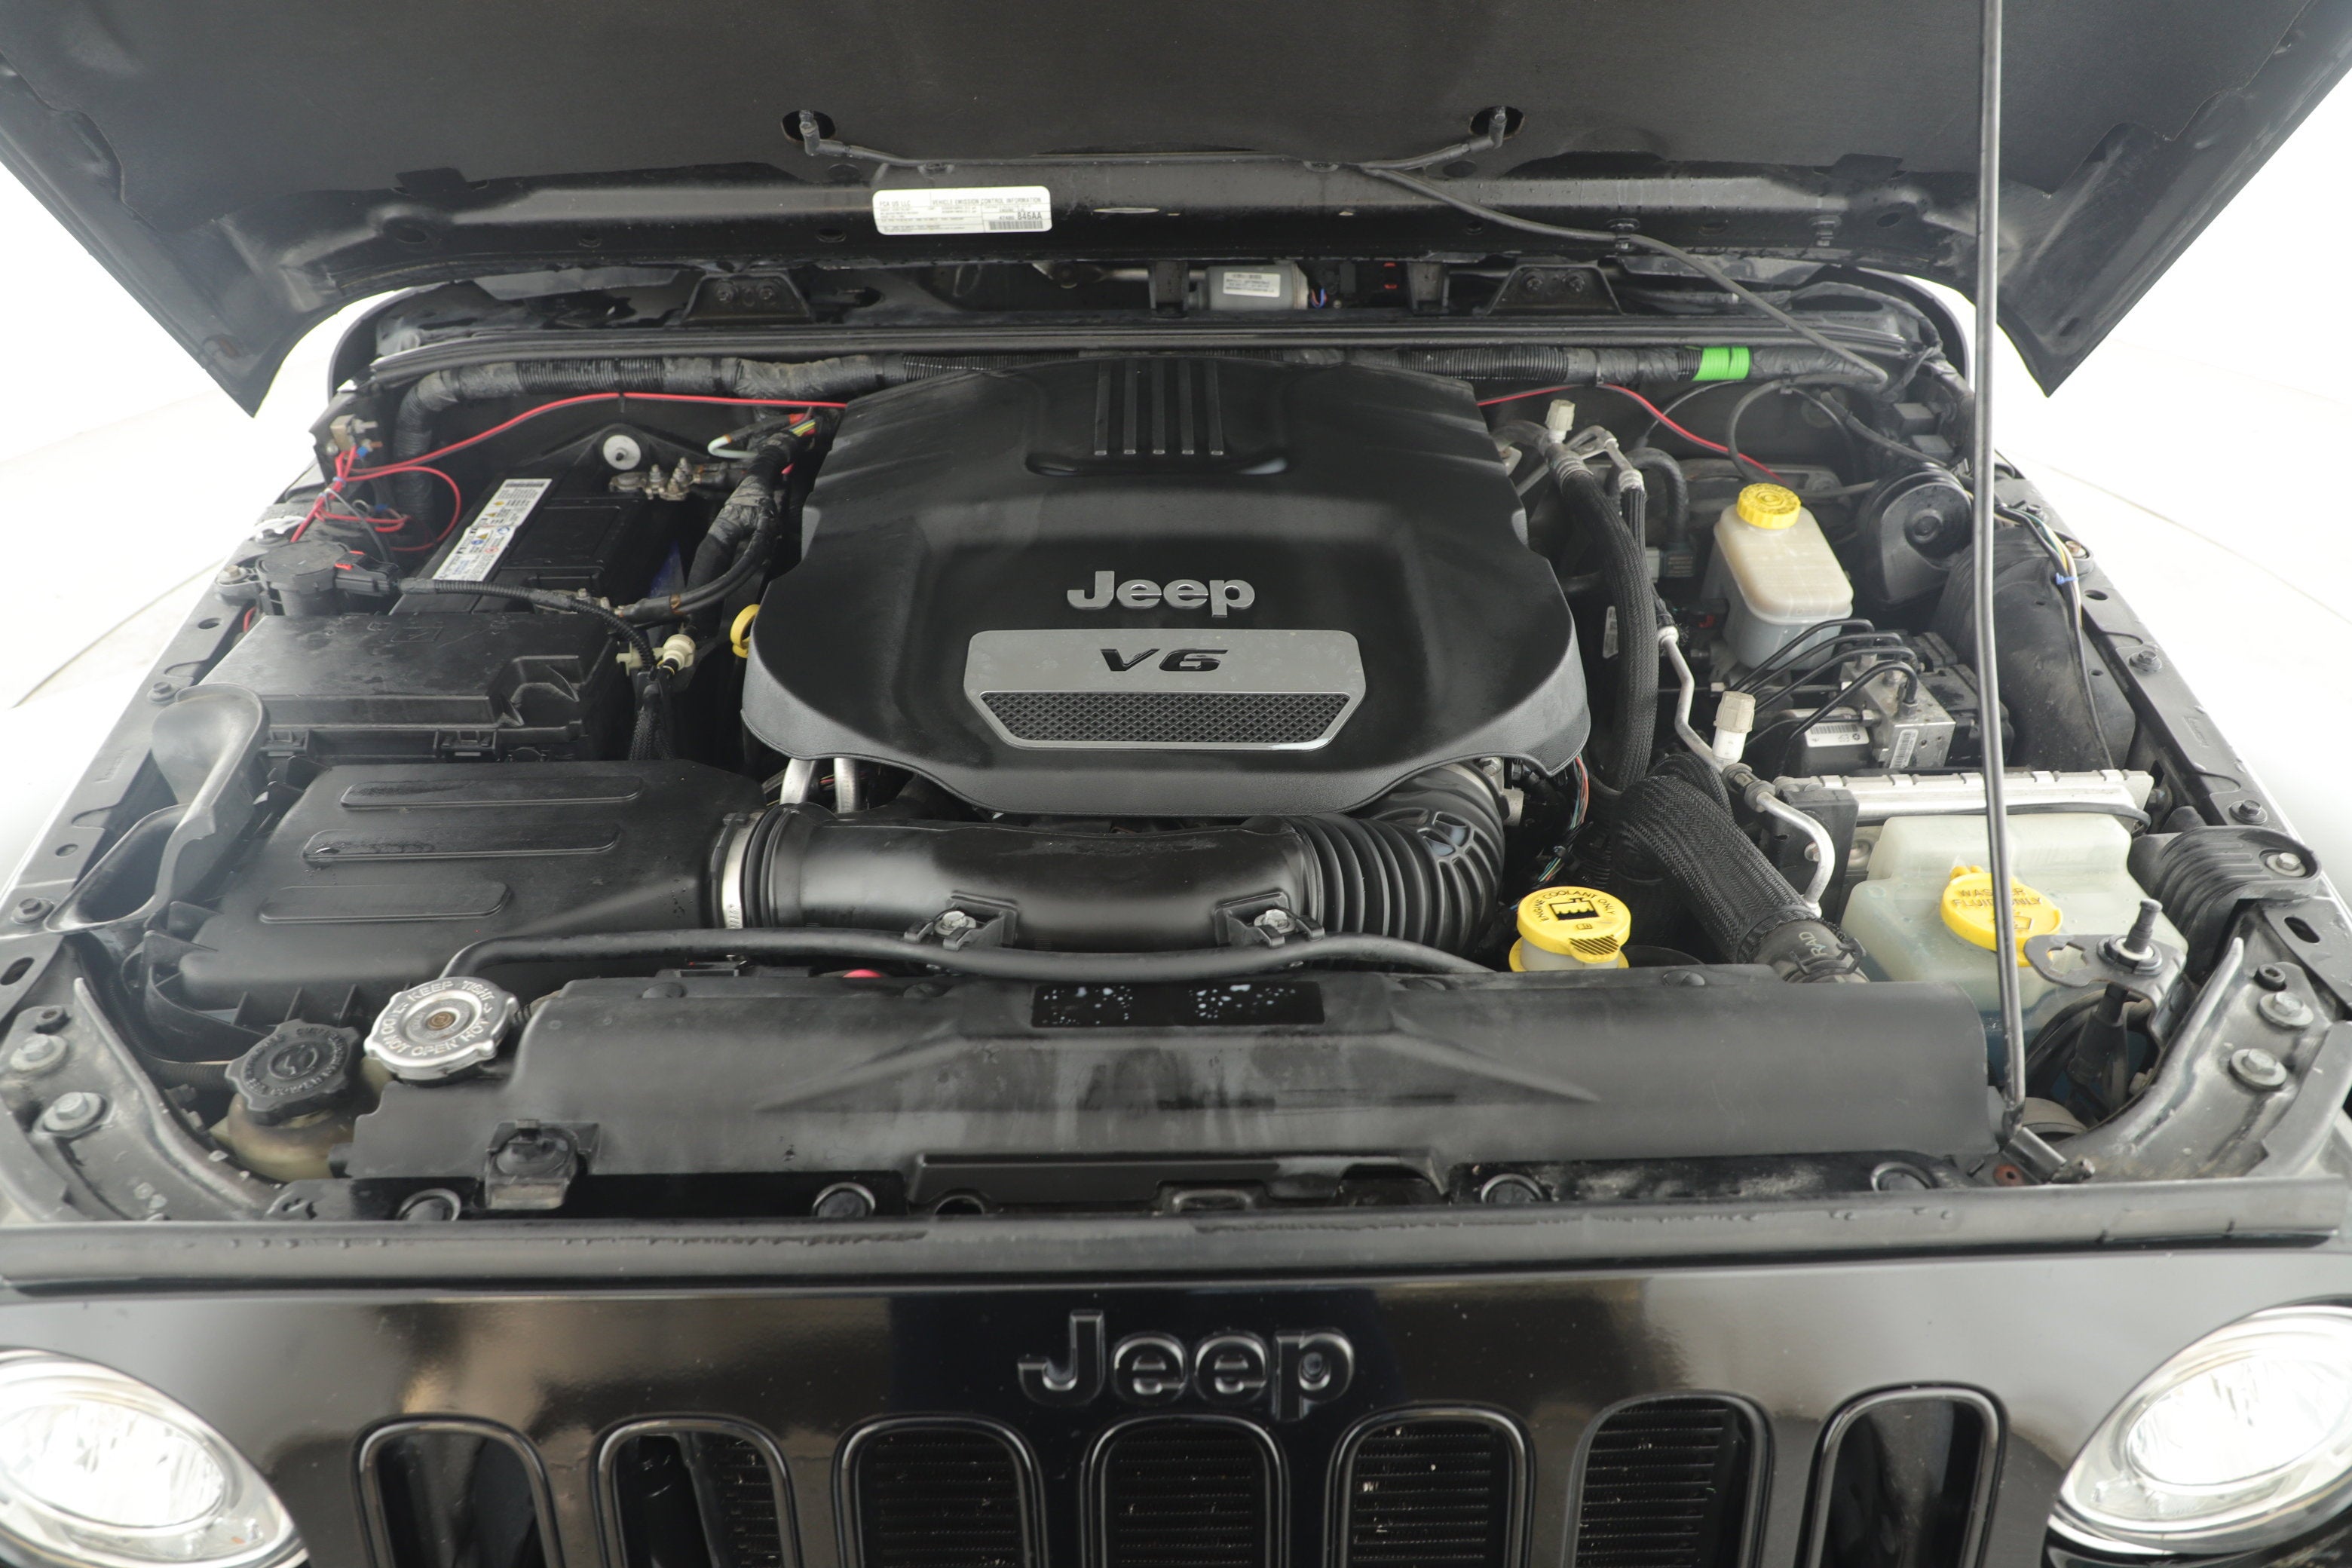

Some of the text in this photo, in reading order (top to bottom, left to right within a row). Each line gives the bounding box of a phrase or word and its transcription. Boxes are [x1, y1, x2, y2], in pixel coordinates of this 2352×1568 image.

[1067, 571, 1255, 618] Jeep
[1100, 648, 1228, 672] V6
[1958, 888, 2026, 897] WASR
[1533, 890, 1616, 922] ENGINE COOLANT ONLY
[1798, 931, 1827, 956] RAD
[407, 981, 495, 1001] KEEP TIGHT
[381, 1018, 397, 1035] DO
[460, 1018, 490, 1042] HOT
[382, 1034, 412, 1053] NOT
[411, 1040, 460, 1056] OPEN
[1017, 1309, 1355, 1422] Jeep
